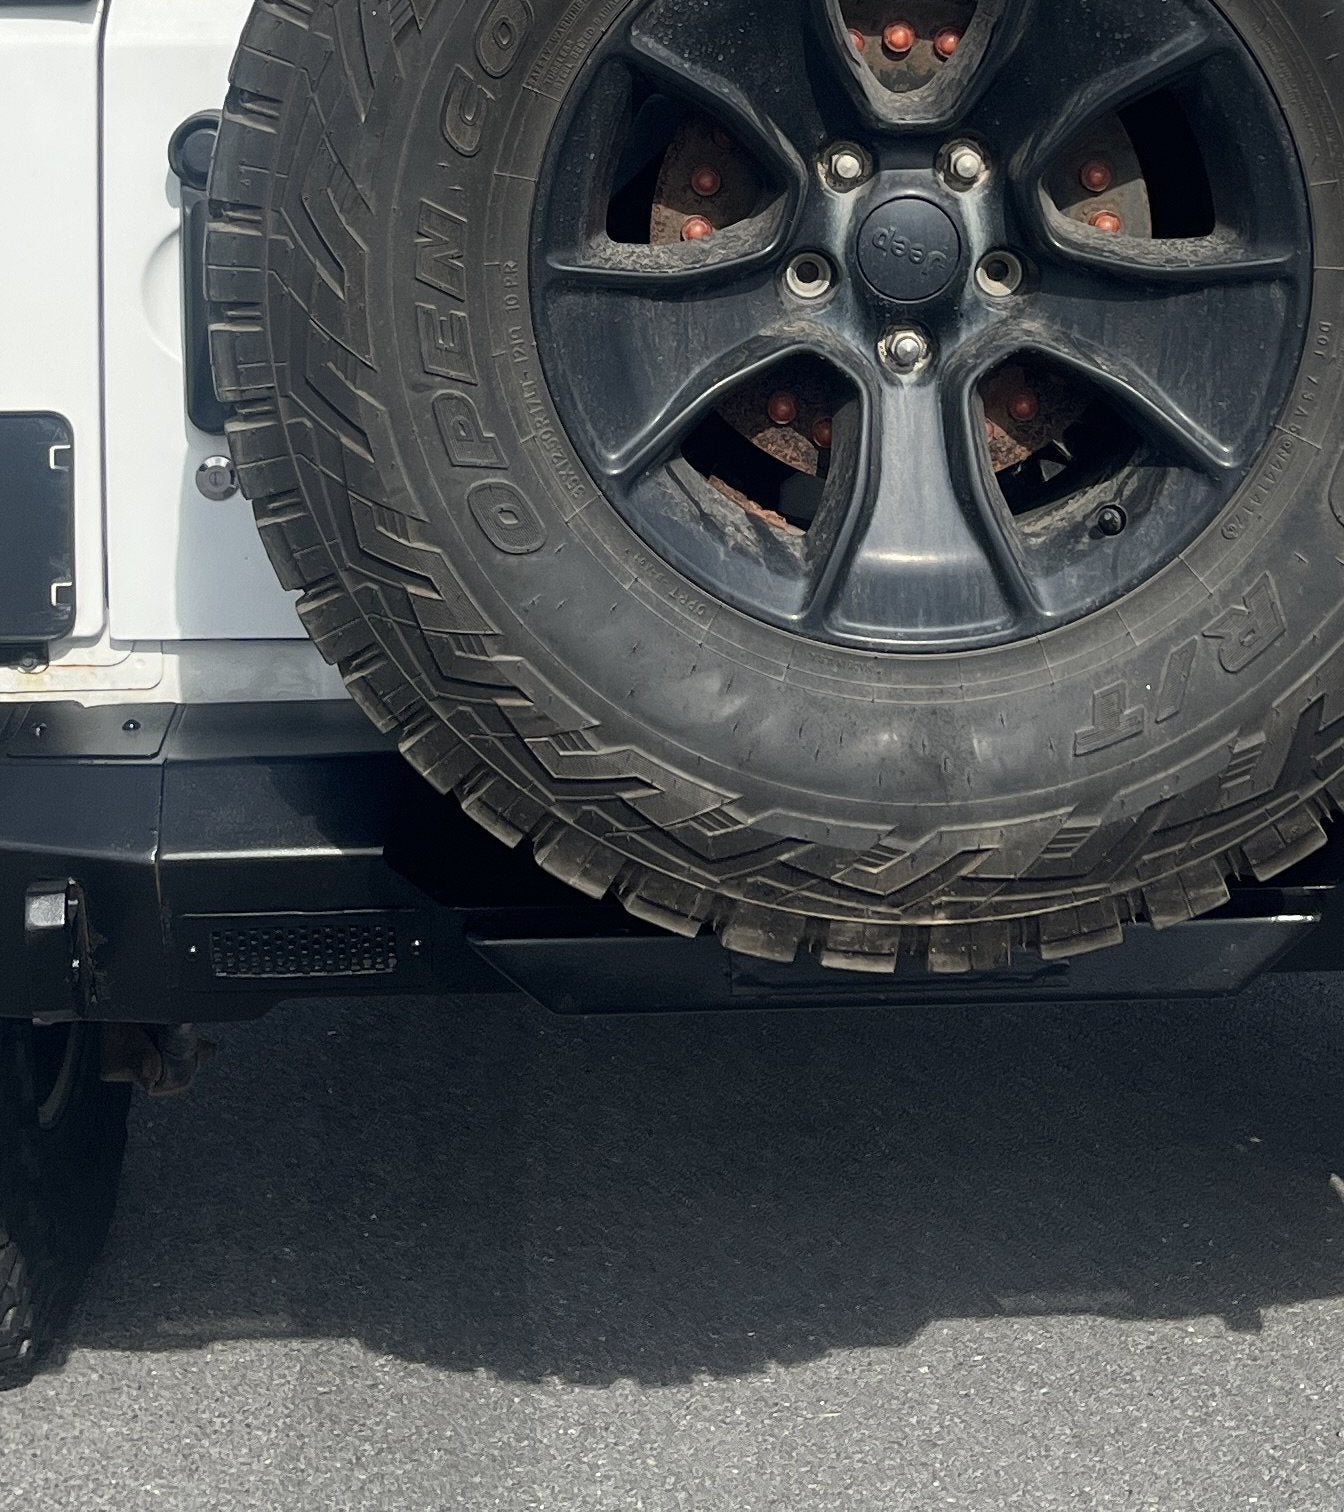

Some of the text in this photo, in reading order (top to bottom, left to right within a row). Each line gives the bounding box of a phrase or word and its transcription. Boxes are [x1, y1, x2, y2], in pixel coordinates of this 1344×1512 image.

[872, 225, 948, 276] Jeep
[410, 195, 547, 554] OPEN
[1071, 567, 1289, 761] R/T
